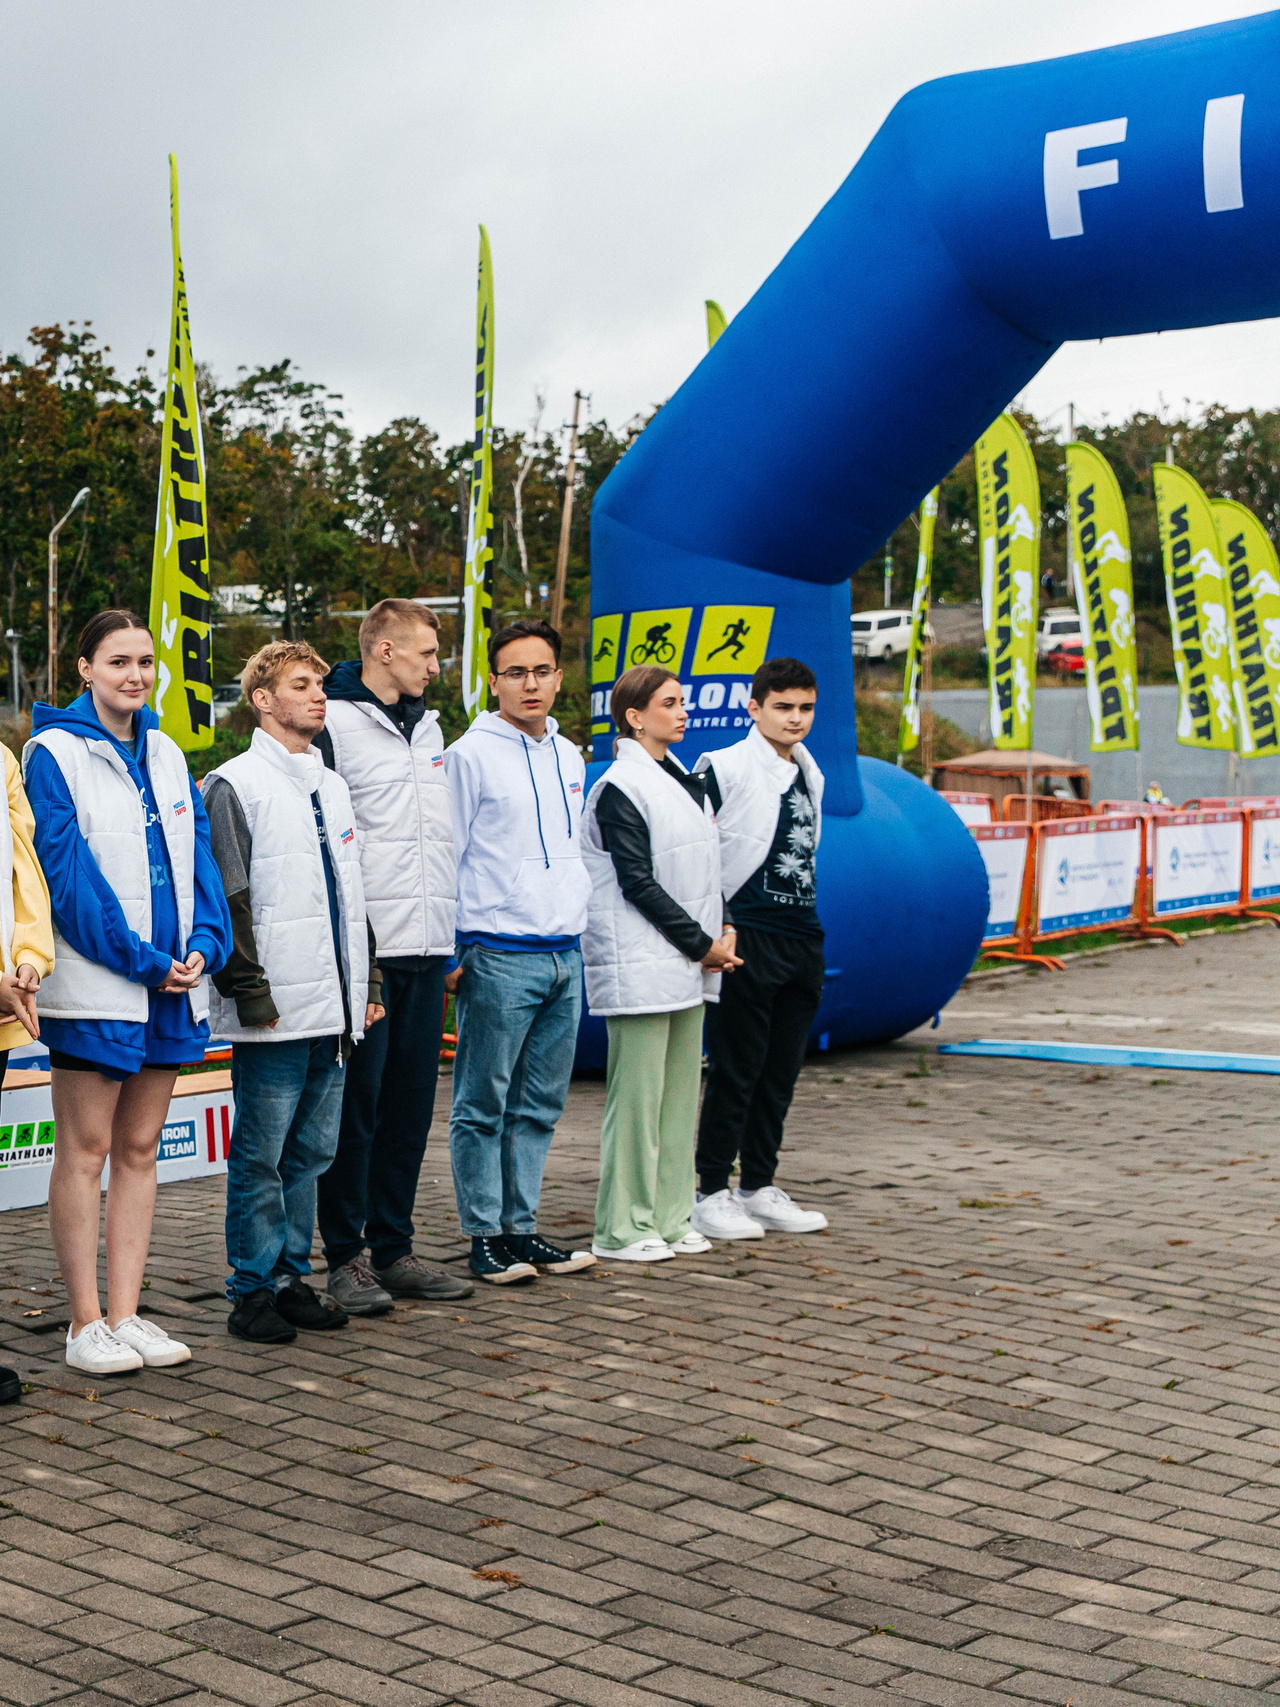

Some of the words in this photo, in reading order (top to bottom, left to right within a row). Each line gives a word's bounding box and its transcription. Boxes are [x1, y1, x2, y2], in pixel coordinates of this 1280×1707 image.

[685, 717, 728, 729] ENTRE
[162, 1125, 190, 1141] IRON
[163, 1141, 195, 1157] TEAM
